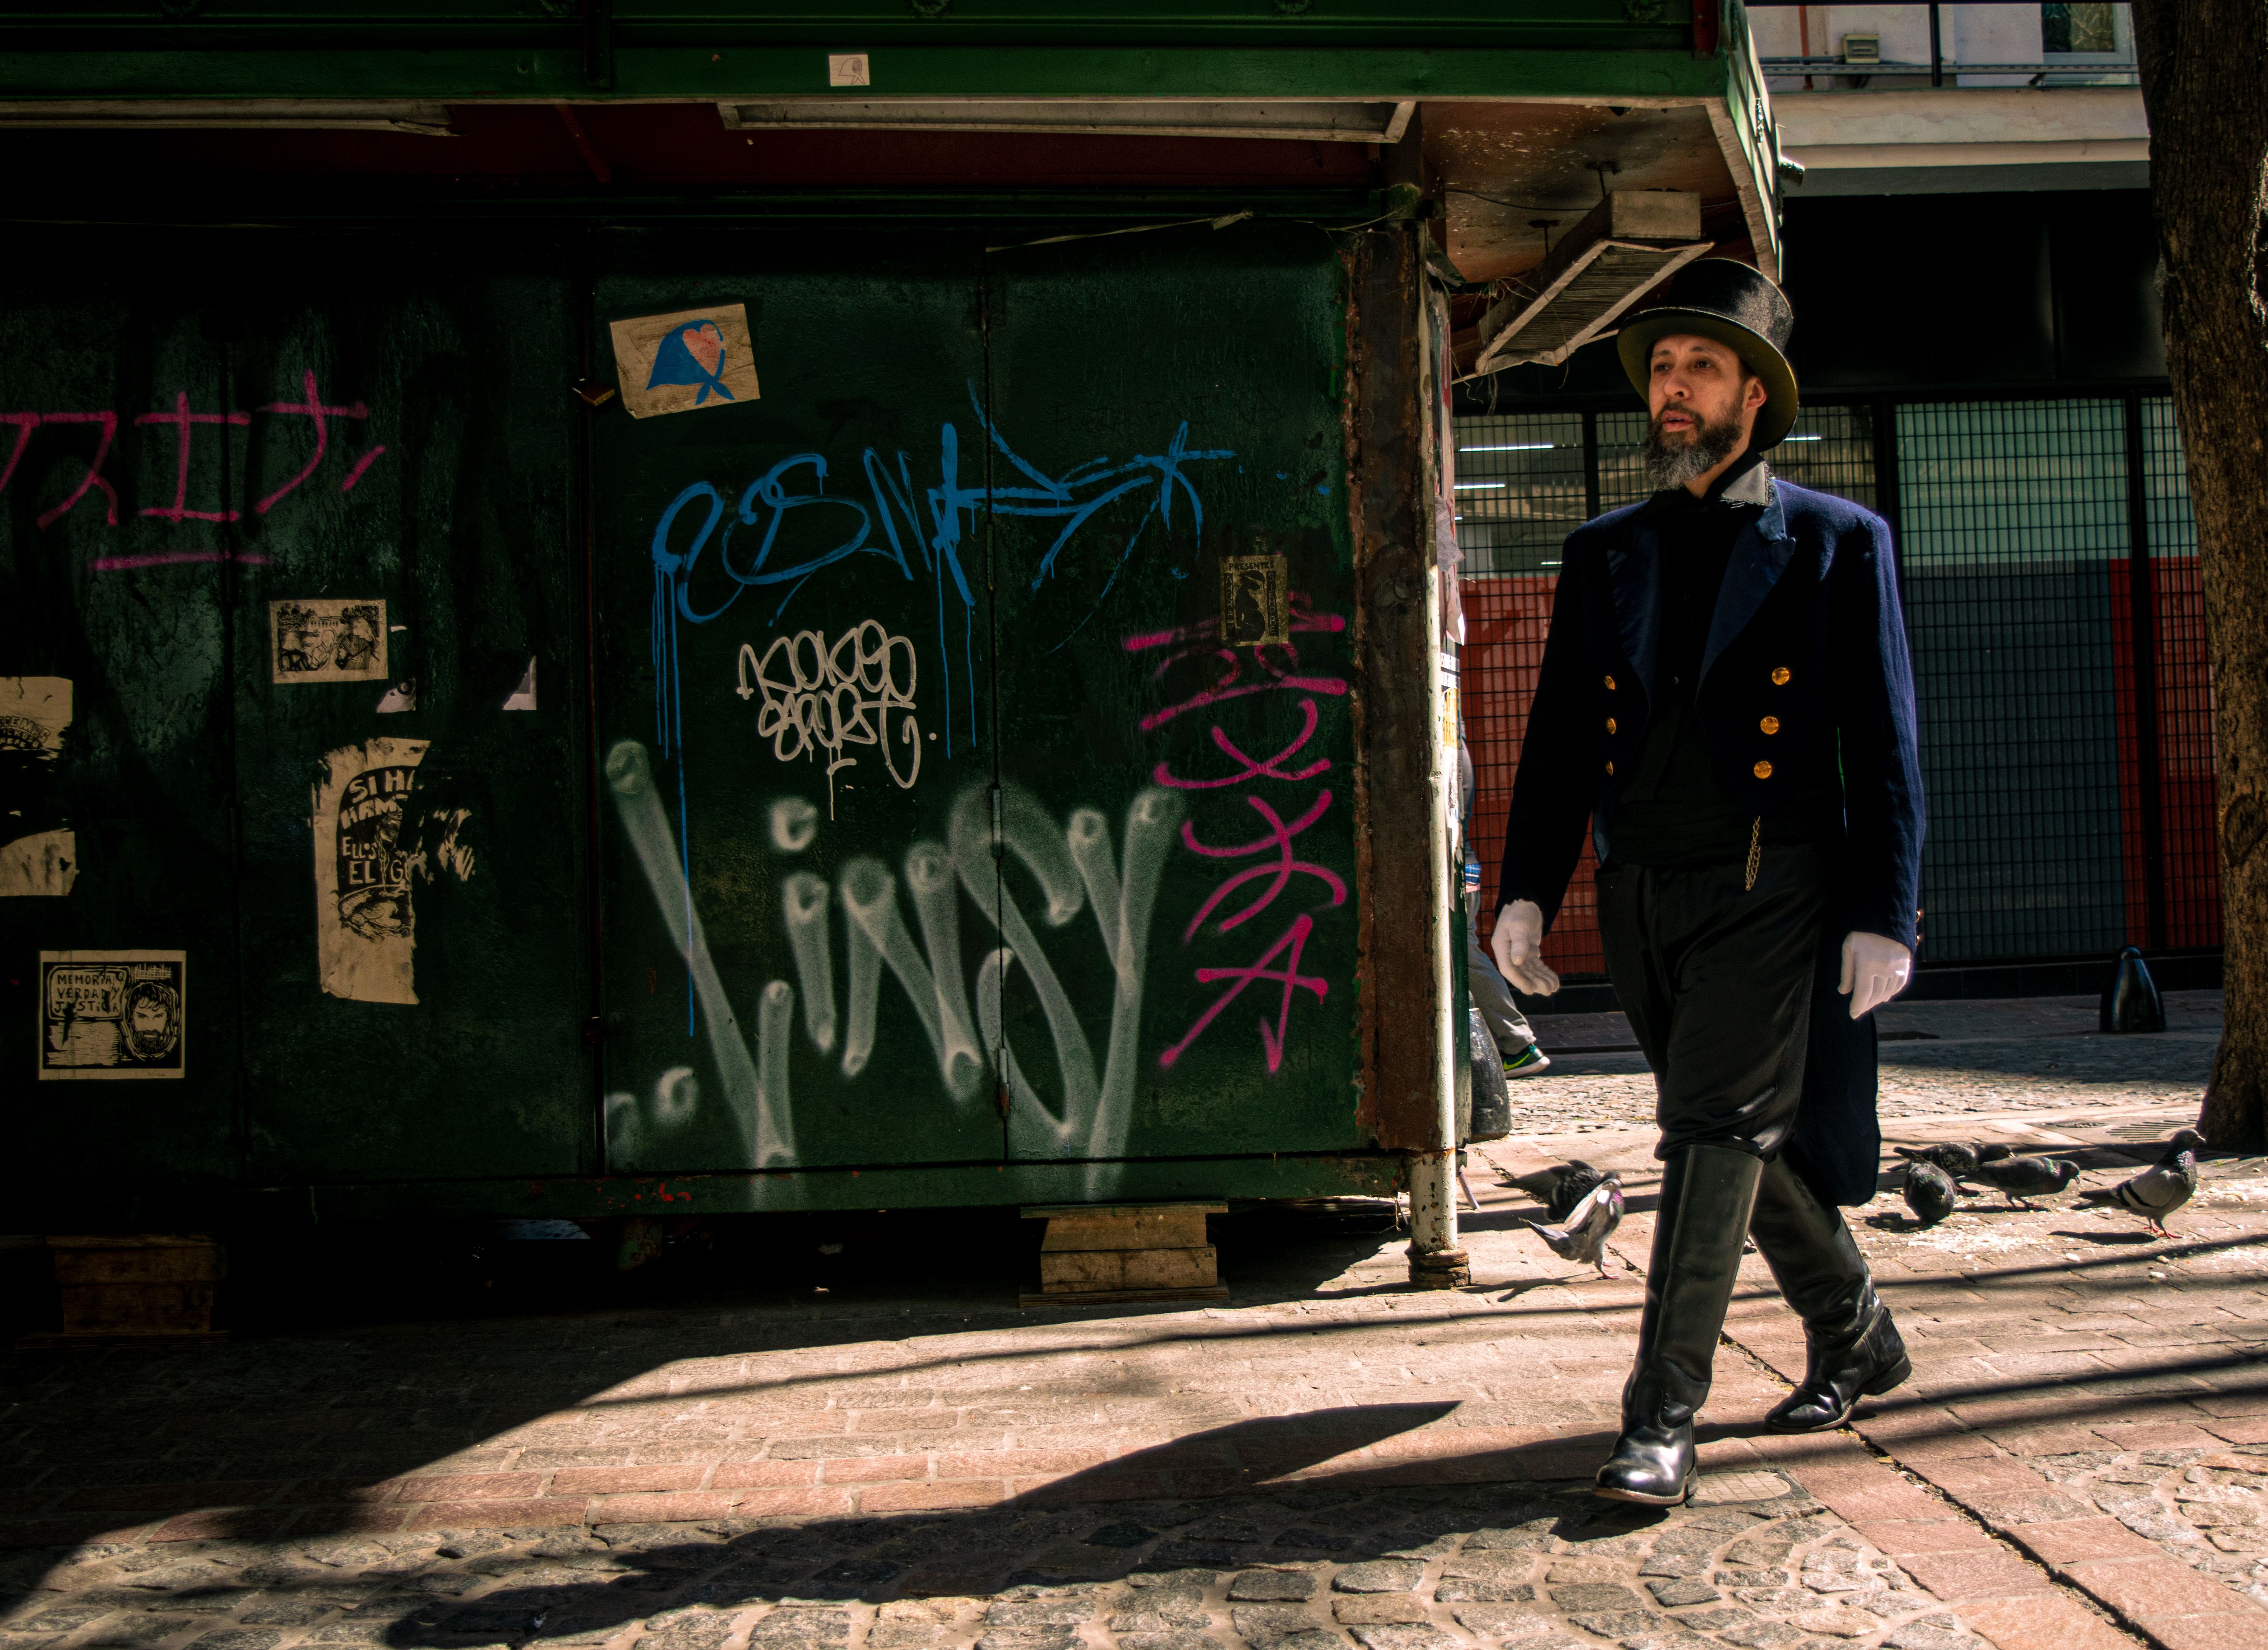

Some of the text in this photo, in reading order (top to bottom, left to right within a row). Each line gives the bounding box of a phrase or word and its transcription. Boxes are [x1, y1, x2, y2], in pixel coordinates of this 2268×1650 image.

[1229, 561, 1274, 571] PRESENTES
[349, 776, 378, 803] SI
[349, 860, 376, 884] EL
